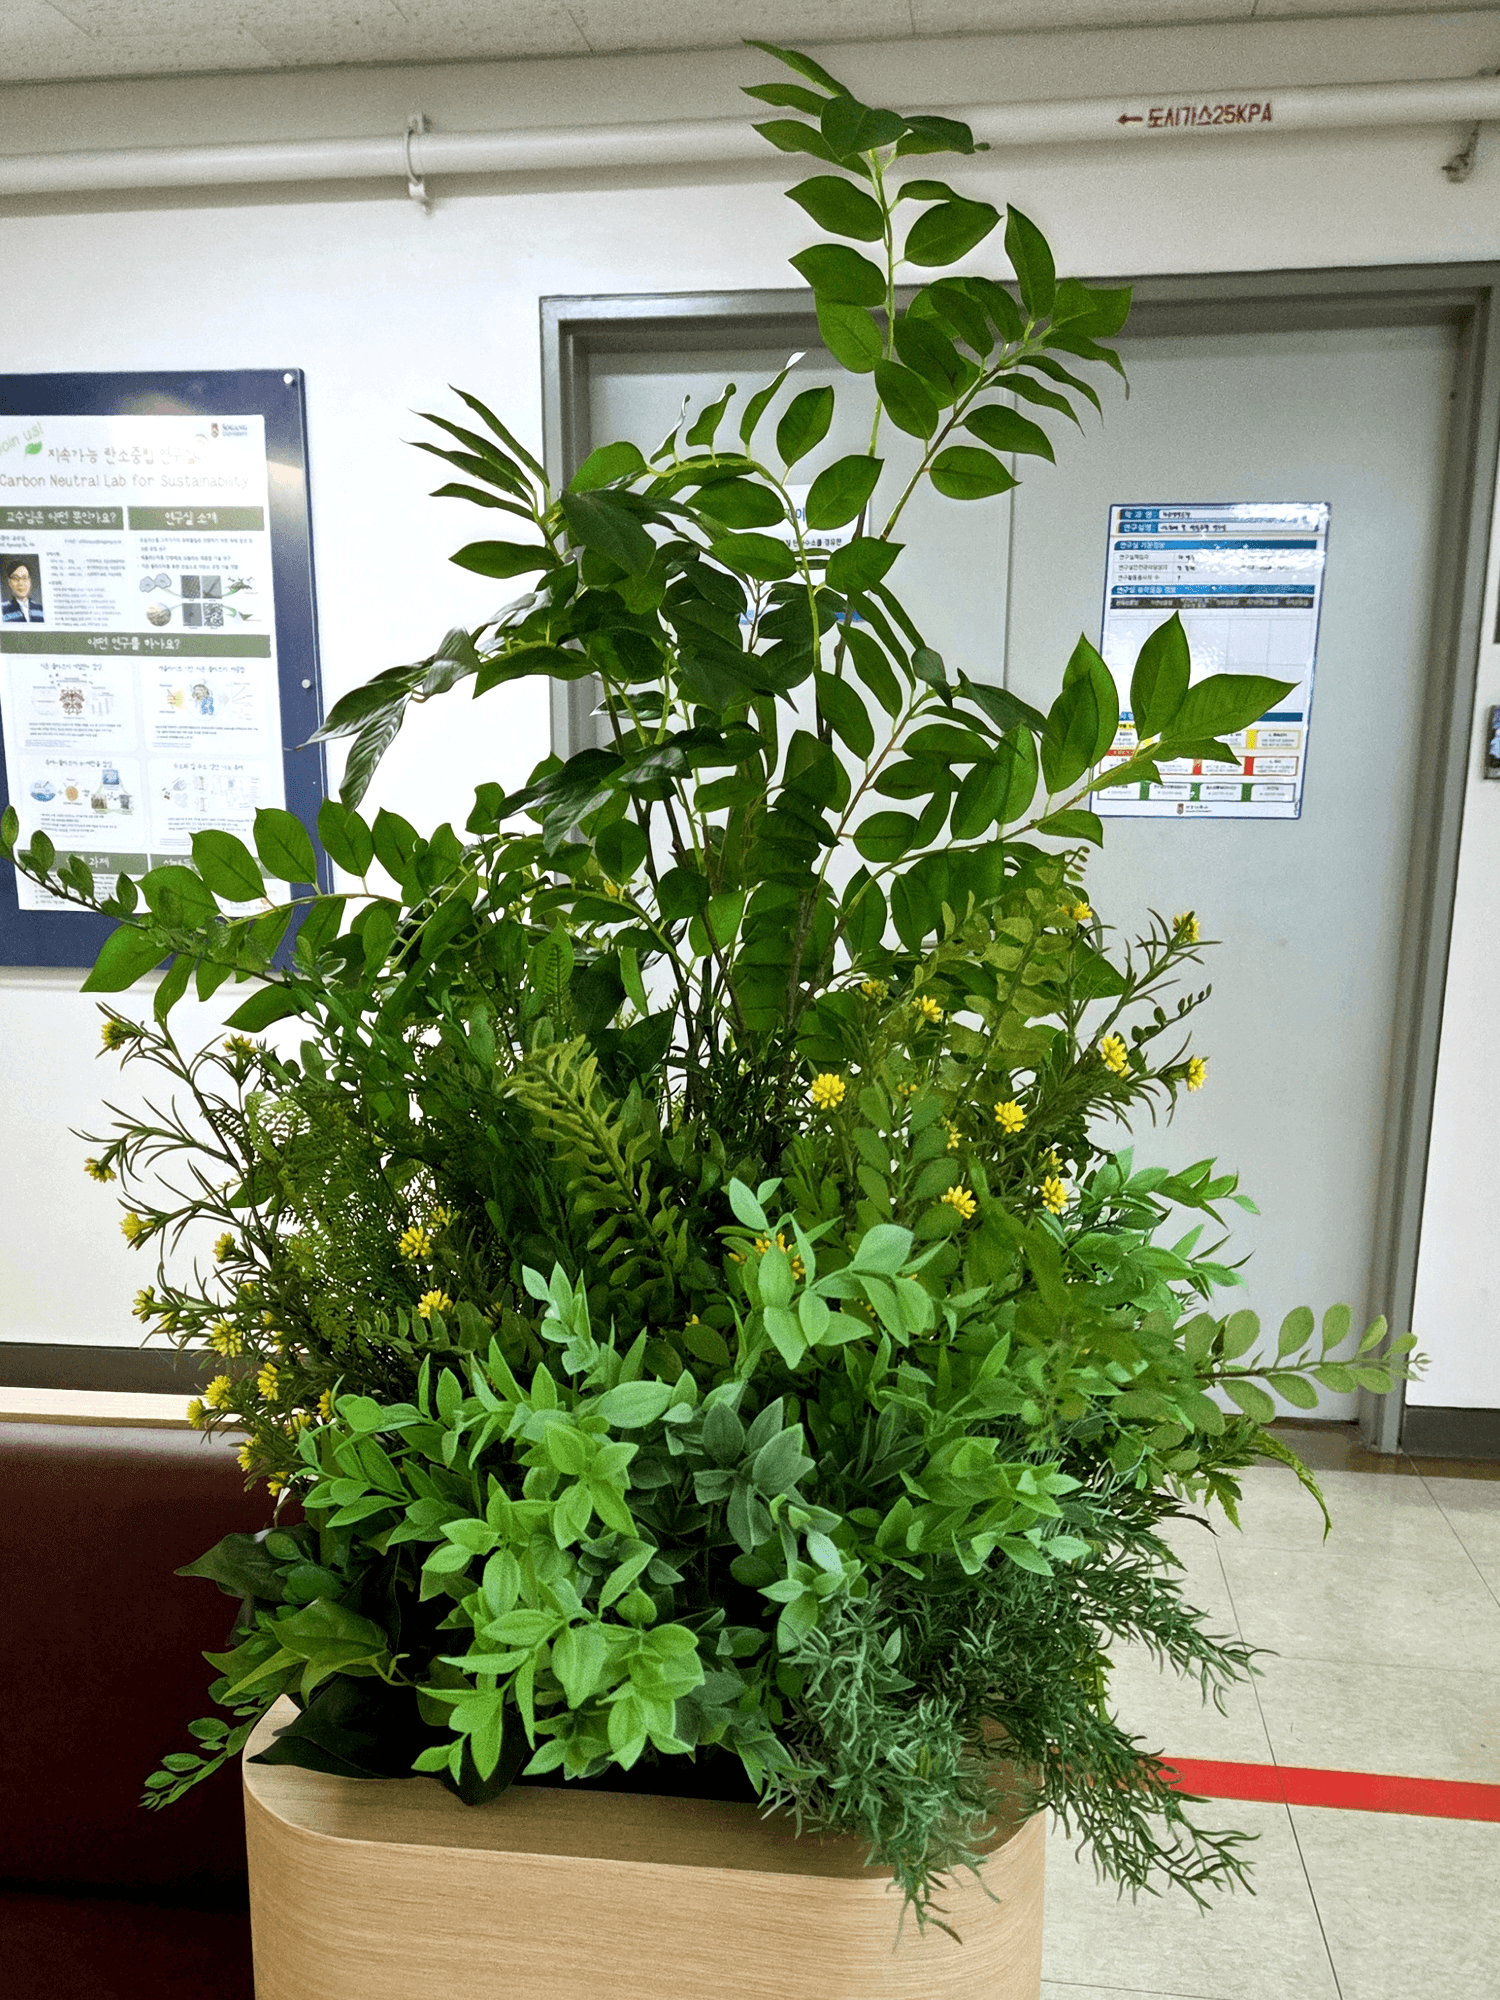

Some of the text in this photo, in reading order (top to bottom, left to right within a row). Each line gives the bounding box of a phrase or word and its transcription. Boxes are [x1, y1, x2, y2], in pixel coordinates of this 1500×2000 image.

[47, 446, 99, 464] 지속가능
[0, 473, 249, 489] Carbon Neutral Lab for Sustainability
[6, 510, 44, 525] 교수님은
[48, 510, 69, 525] 어떤
[164, 511, 194, 526] 연구실
[111, 636, 140, 651] 연구를
